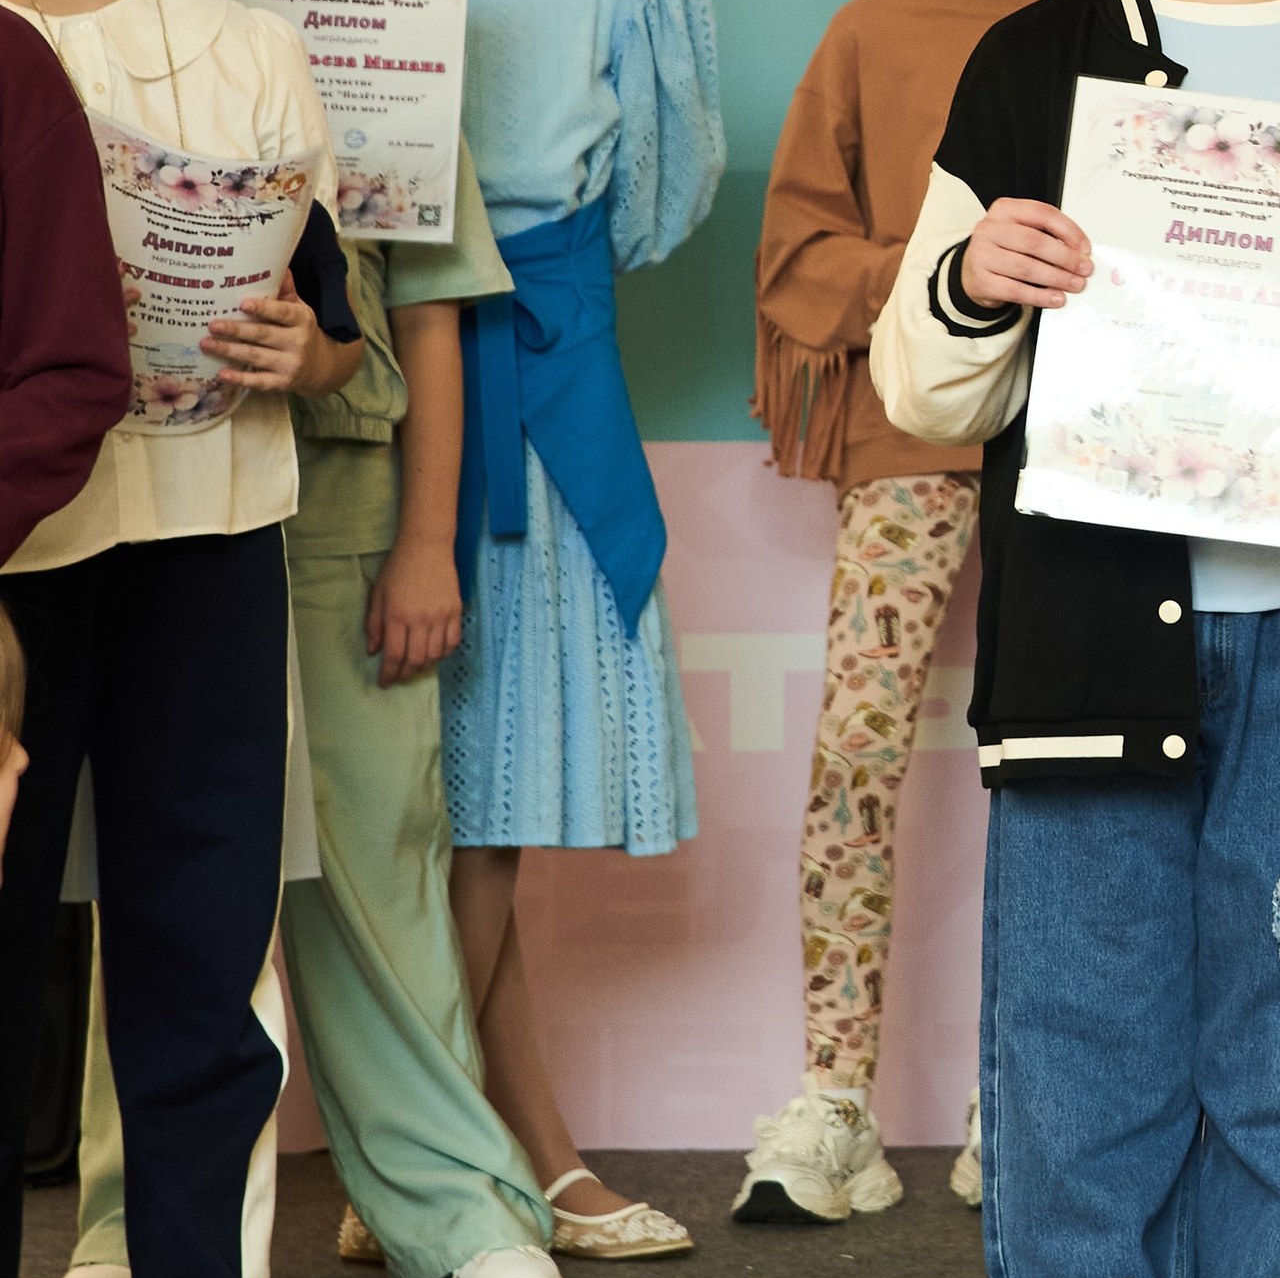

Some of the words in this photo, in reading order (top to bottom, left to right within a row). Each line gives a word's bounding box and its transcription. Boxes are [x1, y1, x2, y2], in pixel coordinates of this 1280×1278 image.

[304, 10, 387, 29] Диплом
[362, 54, 446, 73] Милана
[142, 231, 234, 257] Диплом
[1165, 220, 1273, 252] Диплом
[152, 255, 224, 270] награждается
[1176, 252, 1262, 271] награждается
[220, 269, 271, 289] Лана
